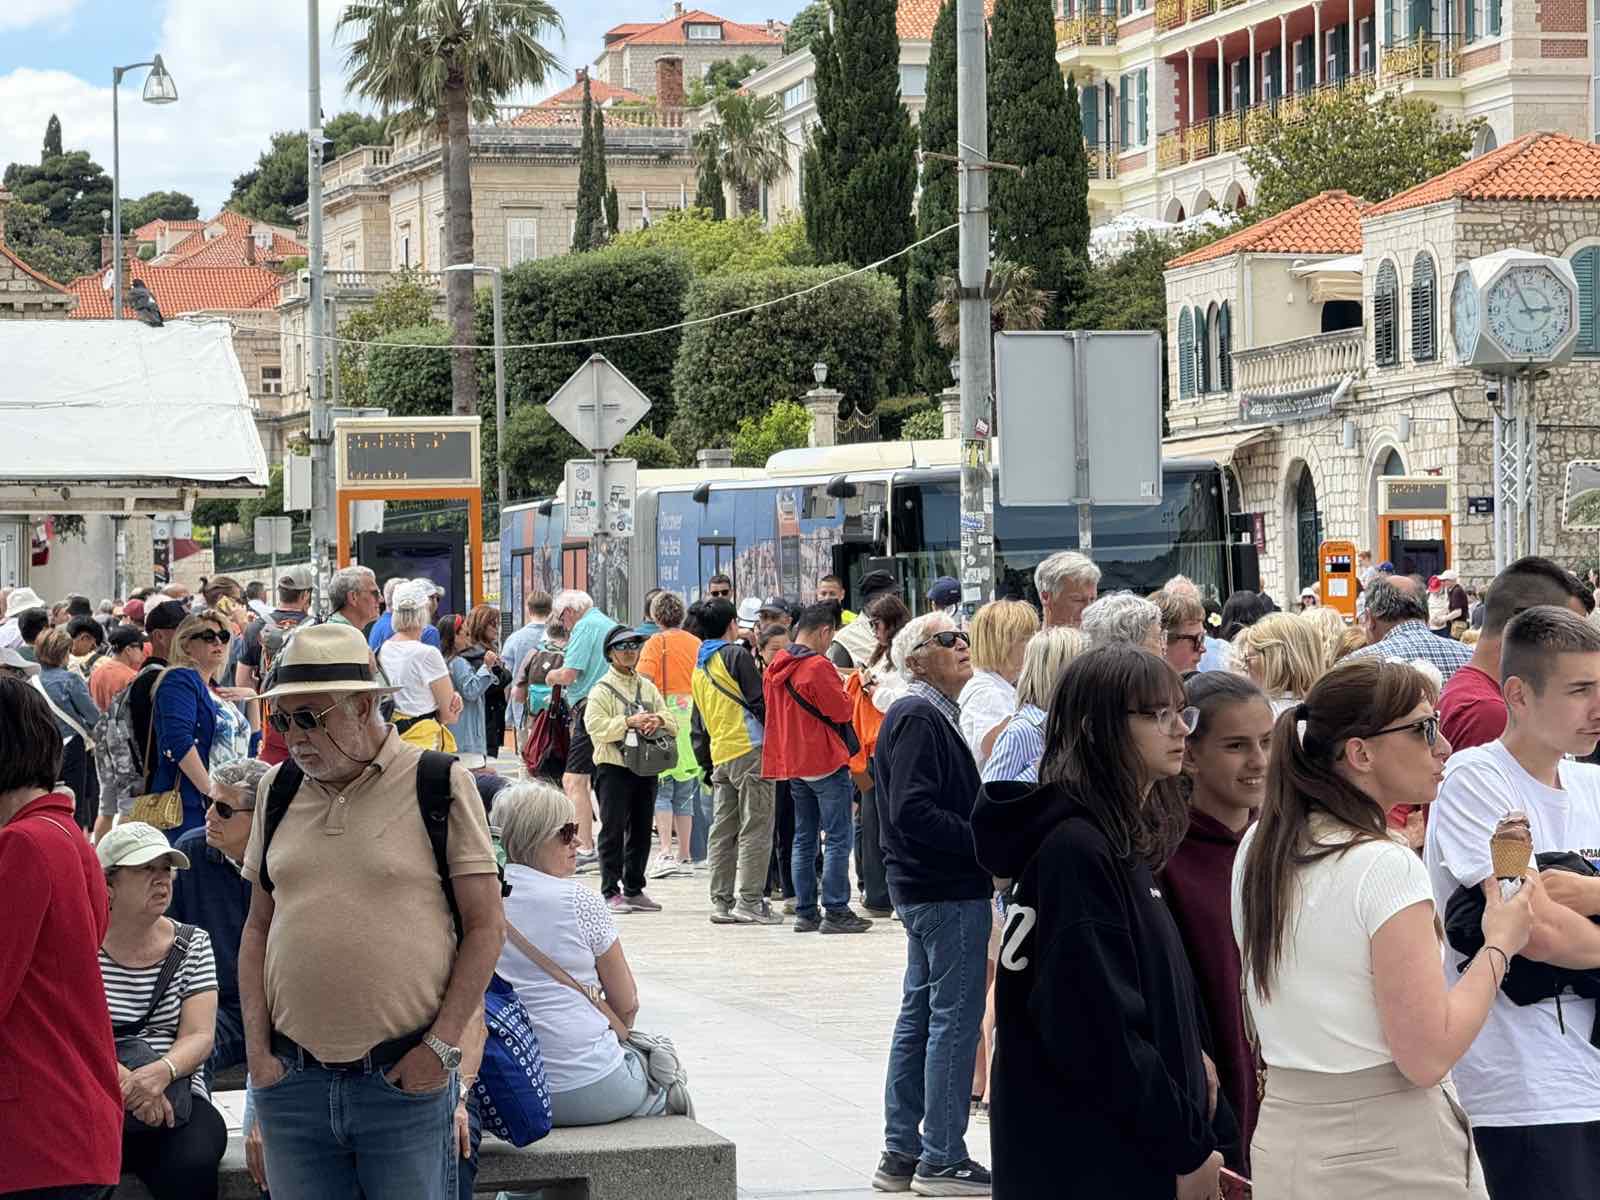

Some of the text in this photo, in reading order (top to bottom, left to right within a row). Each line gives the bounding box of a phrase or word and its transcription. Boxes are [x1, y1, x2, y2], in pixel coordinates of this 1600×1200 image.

[1523, 275, 1536, 286] 12
[1552, 290, 1559, 300] 2
[1493, 305, 1501, 316] 9
[1554, 305, 1562, 316] 3
[1498, 320, 1505, 333] 8
[1552, 320, 1558, 331] 4
[1525, 336, 1532, 347] 6
[1542, 331, 1550, 342] 5
